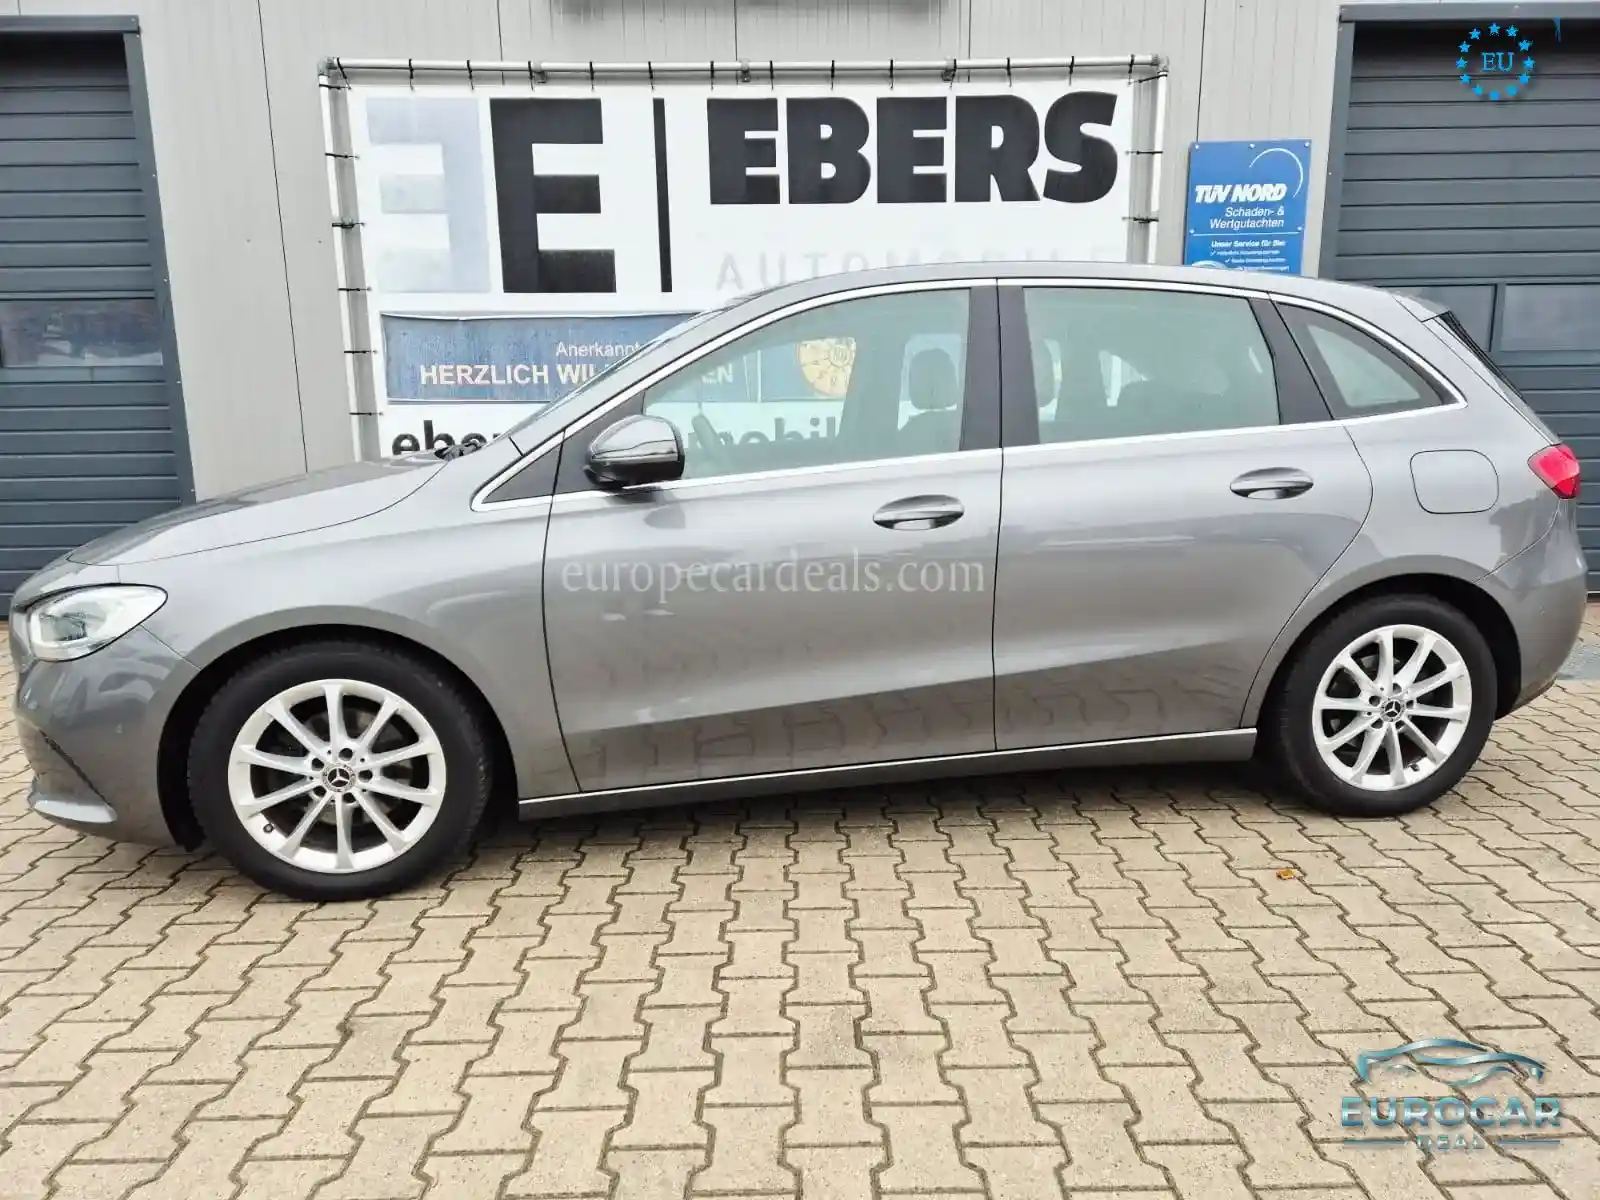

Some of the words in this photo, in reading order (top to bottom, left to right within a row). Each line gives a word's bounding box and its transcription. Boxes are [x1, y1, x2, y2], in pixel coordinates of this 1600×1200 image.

[706, 90, 1118, 205] EBERS
[489, 97, 616, 293] E
[1231, 183, 1288, 202] NORD
[1225, 206, 1274, 218] Schaden-
[1277, 205, 1285, 216] &
[1210, 218, 1285, 231] Wertgutachten
[420, 364, 549, 386] HERZLICH
